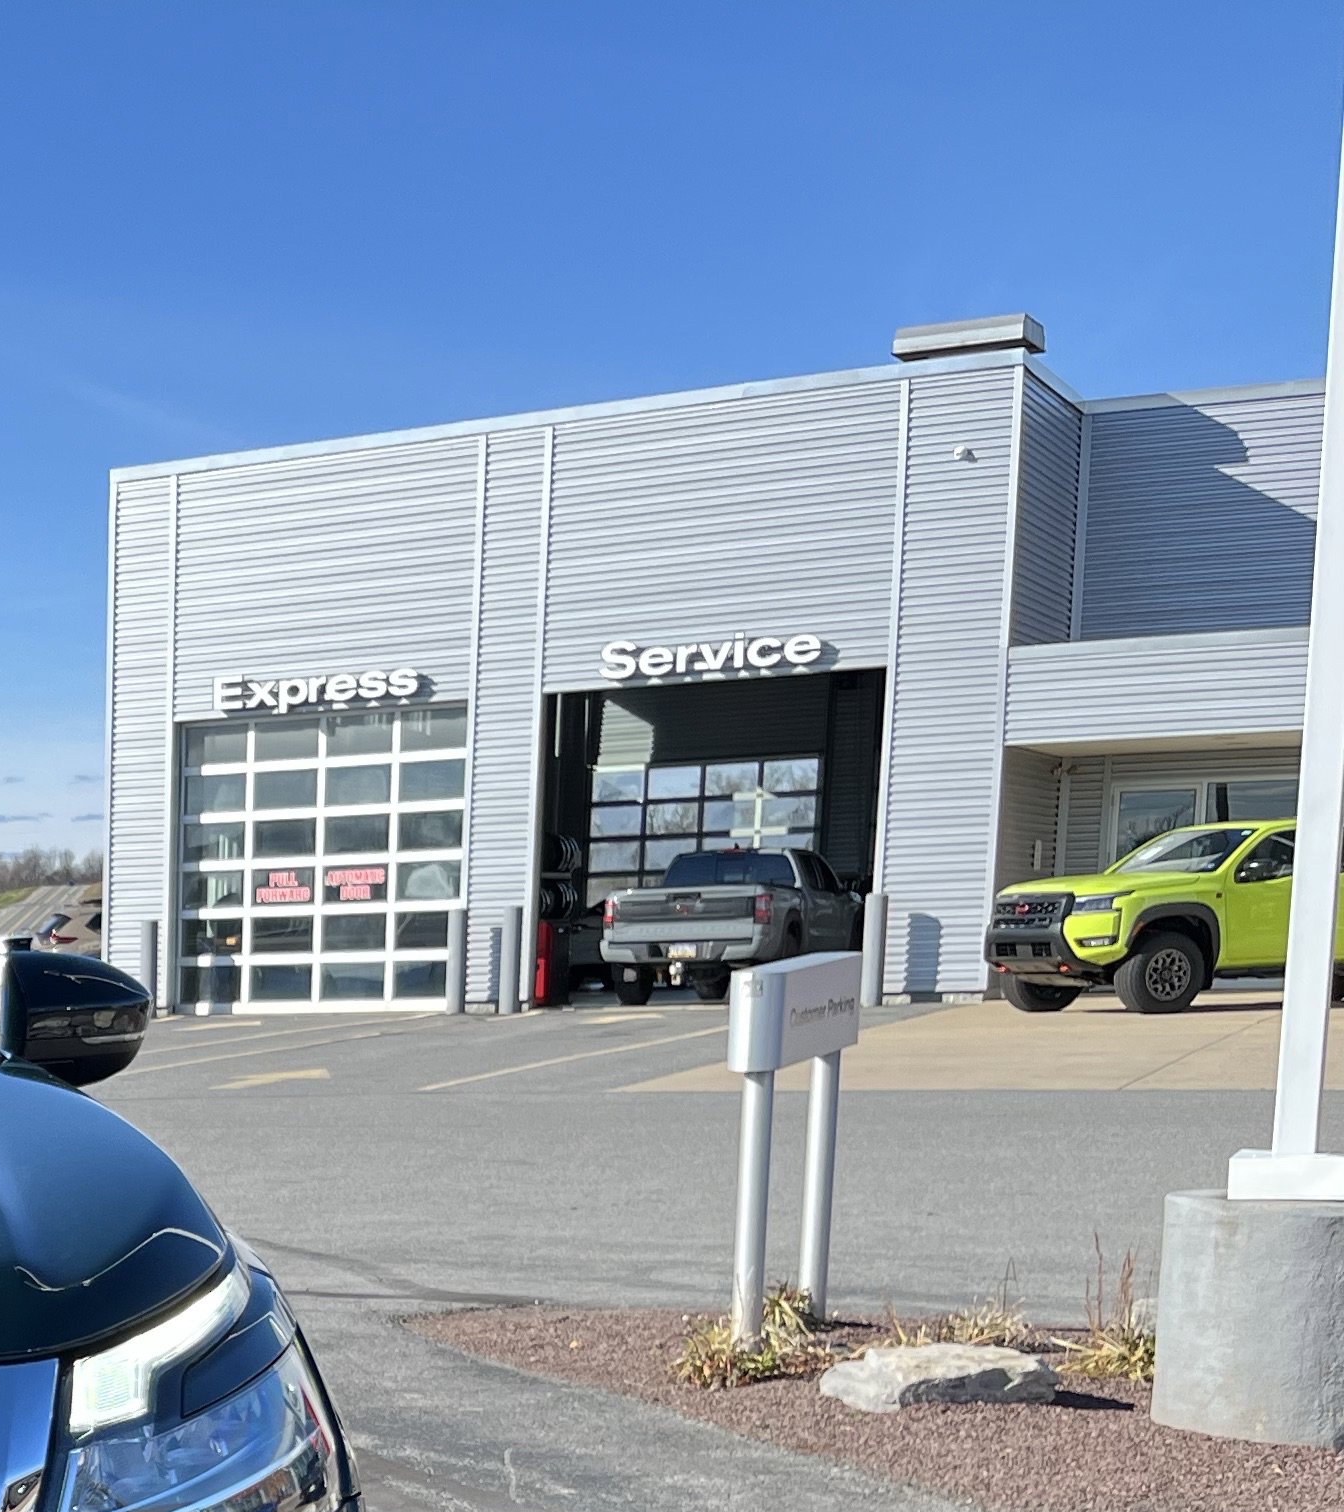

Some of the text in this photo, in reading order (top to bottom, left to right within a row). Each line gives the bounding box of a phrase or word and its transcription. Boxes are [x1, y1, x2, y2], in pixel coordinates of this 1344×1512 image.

[598, 632, 823, 681] Service
[212, 668, 419, 714] Express
[269, 871, 298, 887] PULL
[325, 868, 385, 886] AUTOMATIC
[256, 887, 310, 903] FORWARD
[340, 885, 371, 900] DOOR
[827, 996, 855, 1017] Parking
